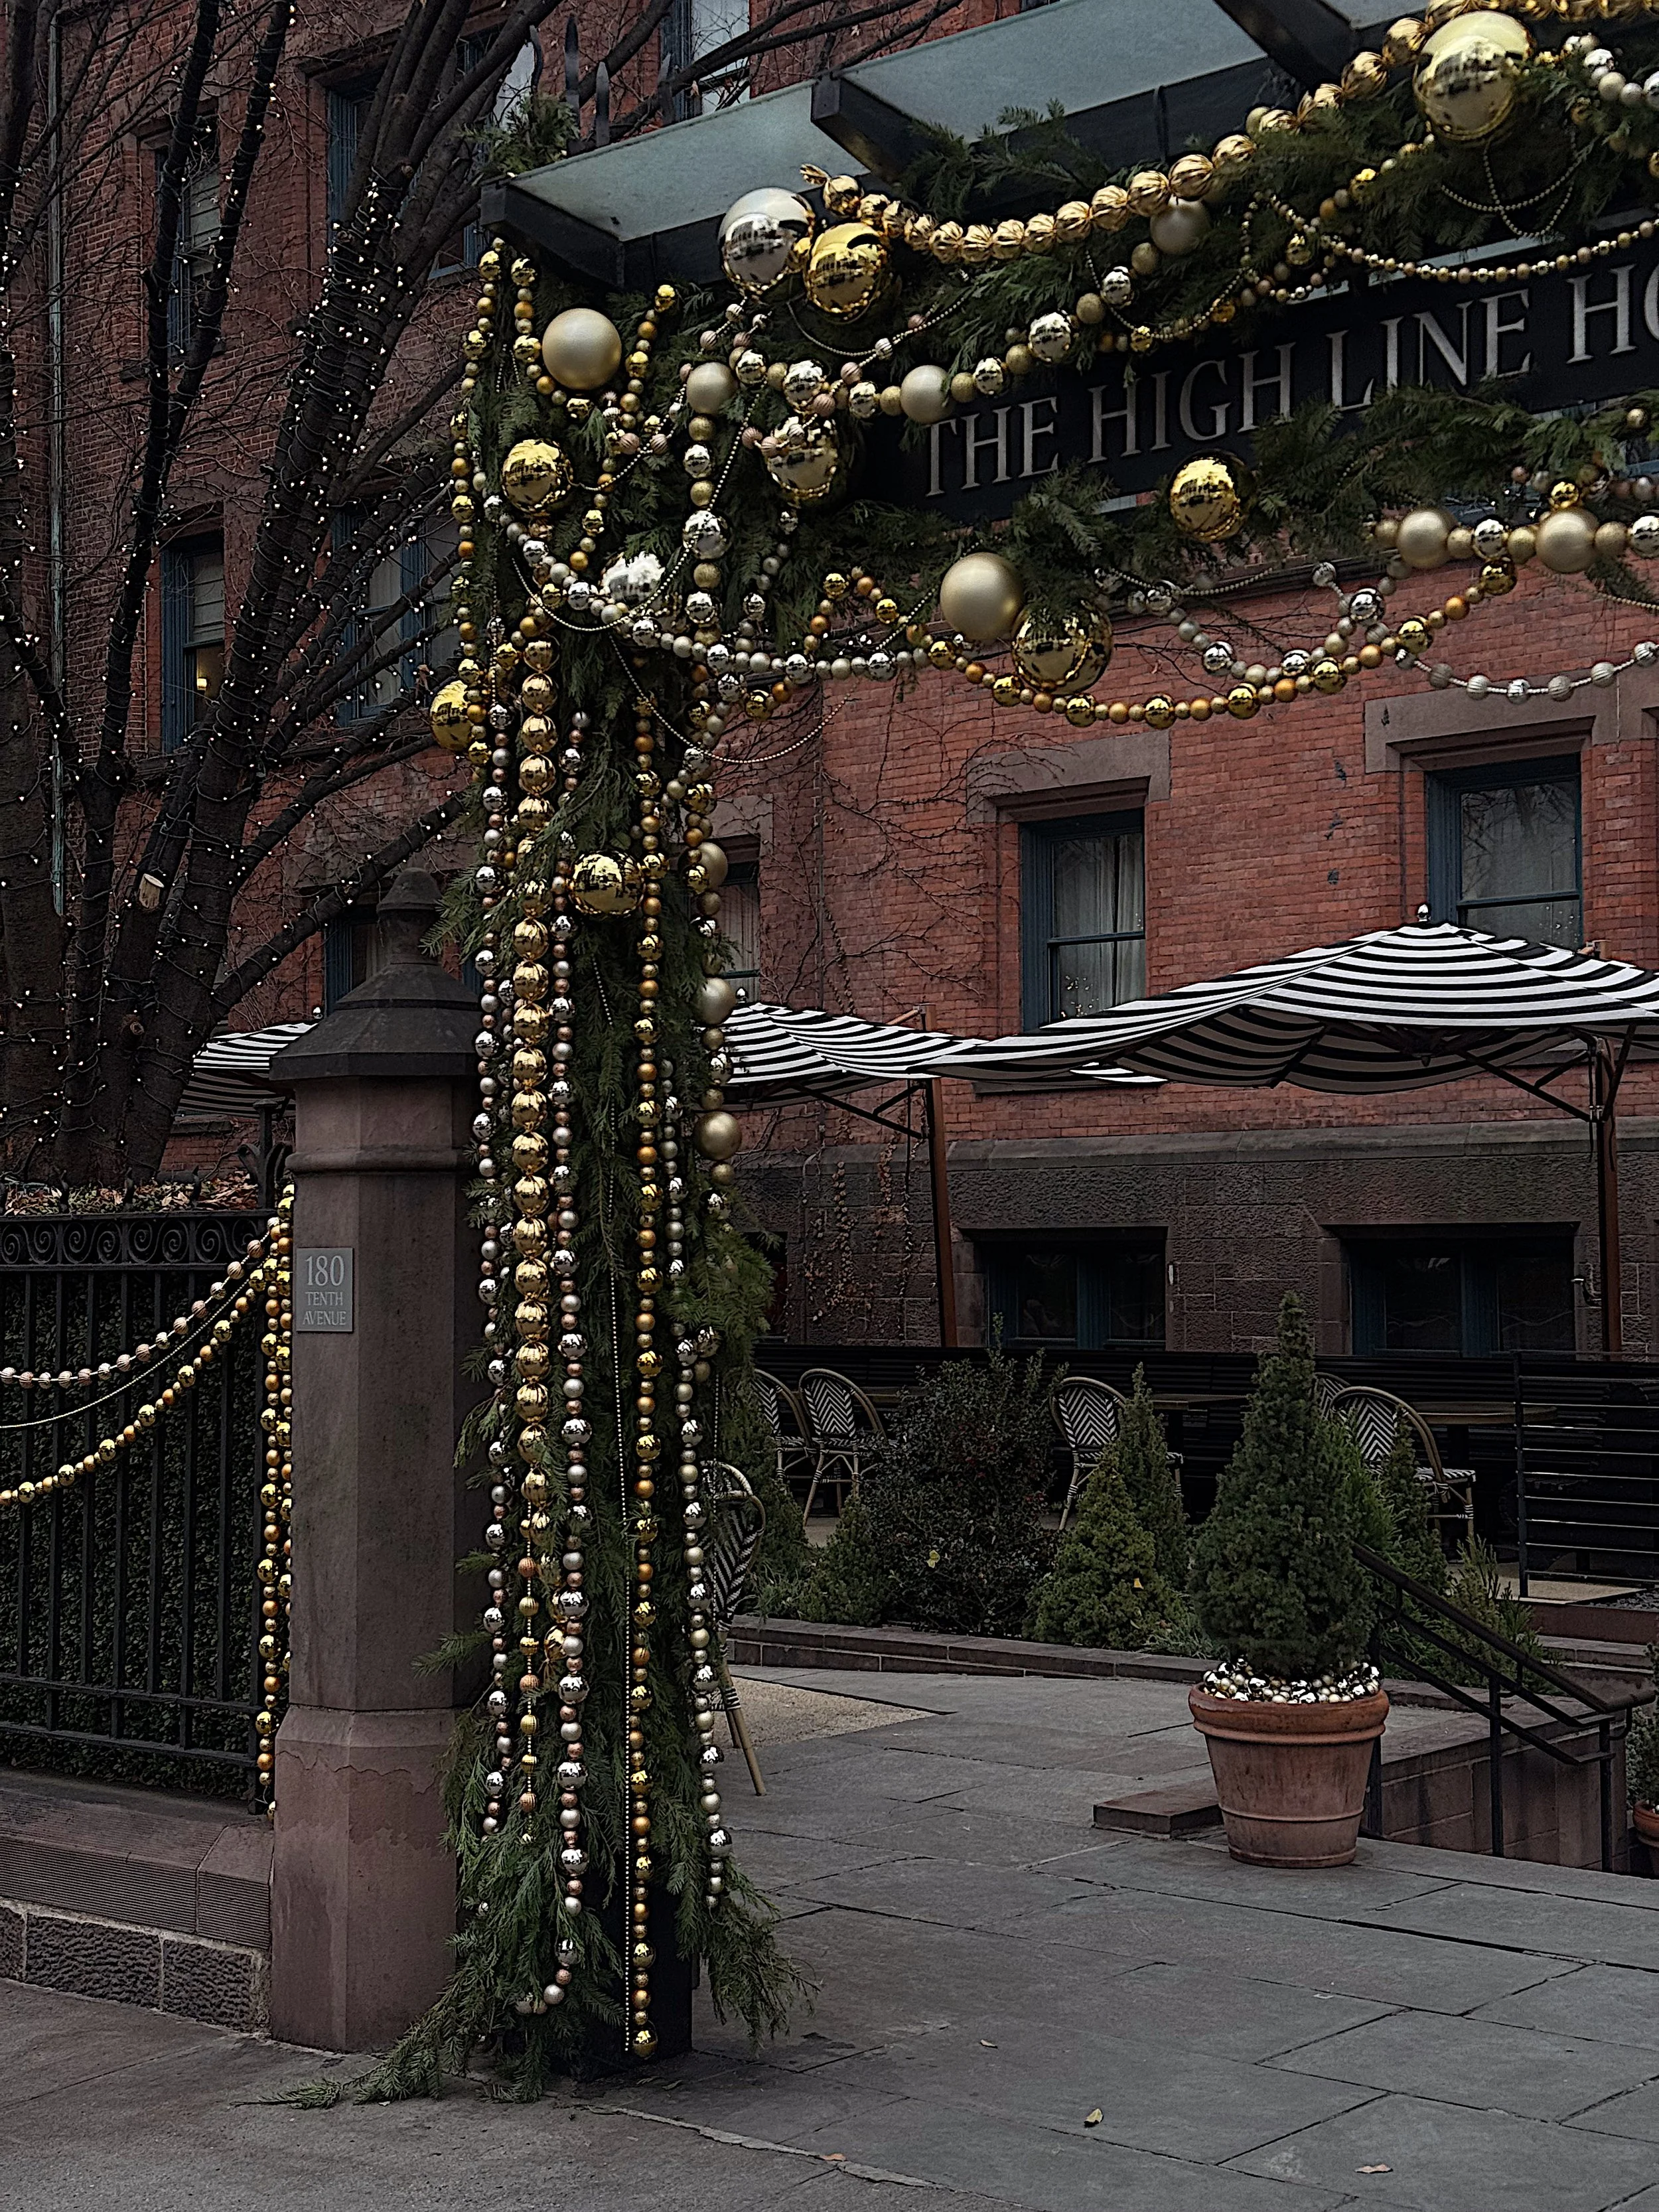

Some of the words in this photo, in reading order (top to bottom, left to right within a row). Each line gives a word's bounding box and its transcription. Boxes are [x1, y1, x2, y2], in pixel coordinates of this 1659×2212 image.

[921, 396, 1058, 496] THE
[1087, 341, 1296, 464] HIGH
[1326, 288, 1530, 411] LINE
[1565, 263, 1659, 364] H
[305, 1255, 344, 1286] 180
[305, 1291, 344, 1306] TENTH
[302, 1310, 347, 1326] AVENUE
